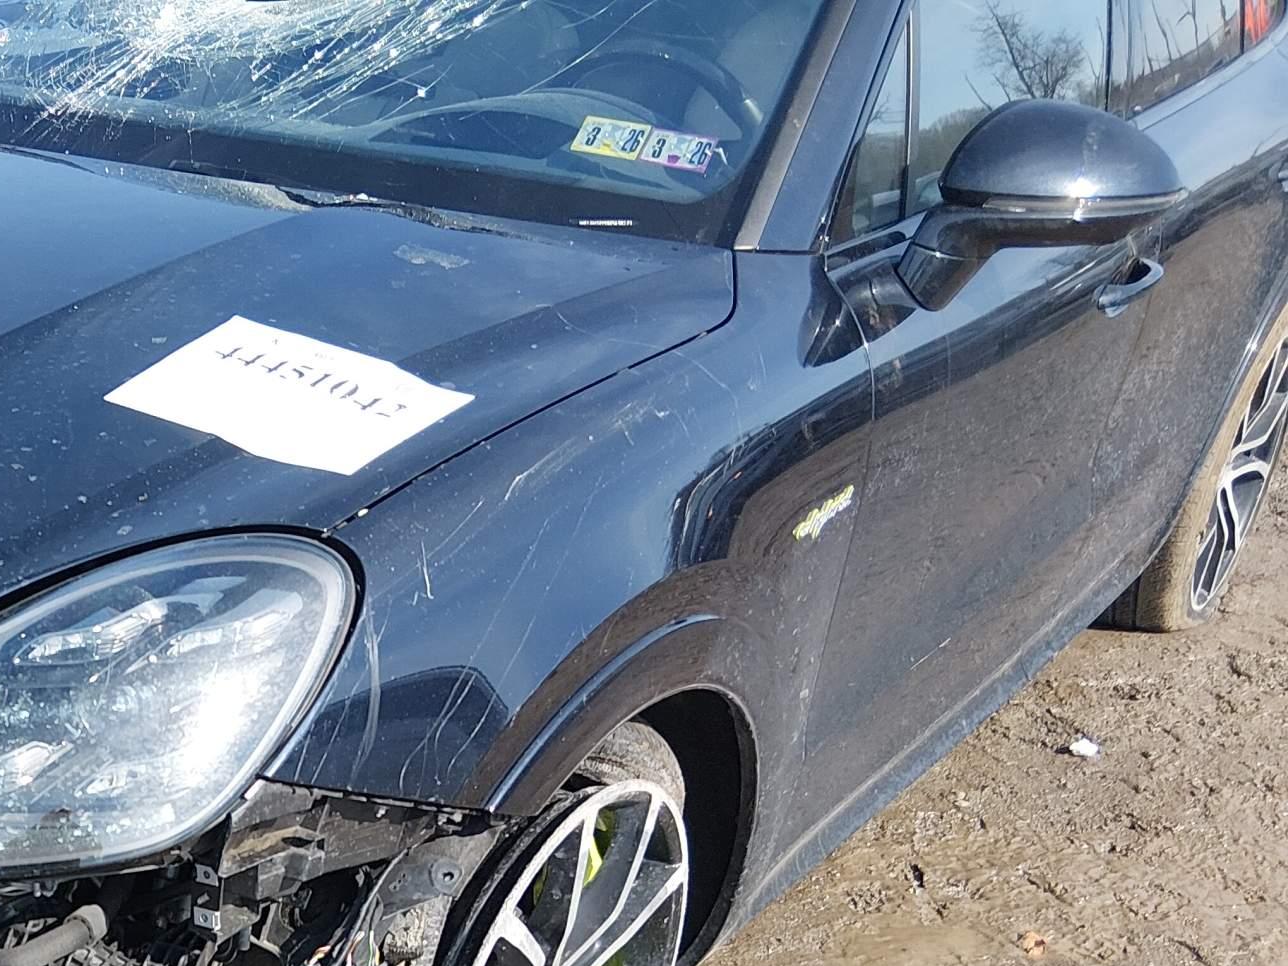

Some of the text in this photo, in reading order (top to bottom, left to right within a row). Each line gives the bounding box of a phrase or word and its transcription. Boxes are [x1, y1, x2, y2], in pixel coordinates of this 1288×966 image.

[585, 126, 645, 153] 3 26
[651, 138, 712, 165] 3 26
